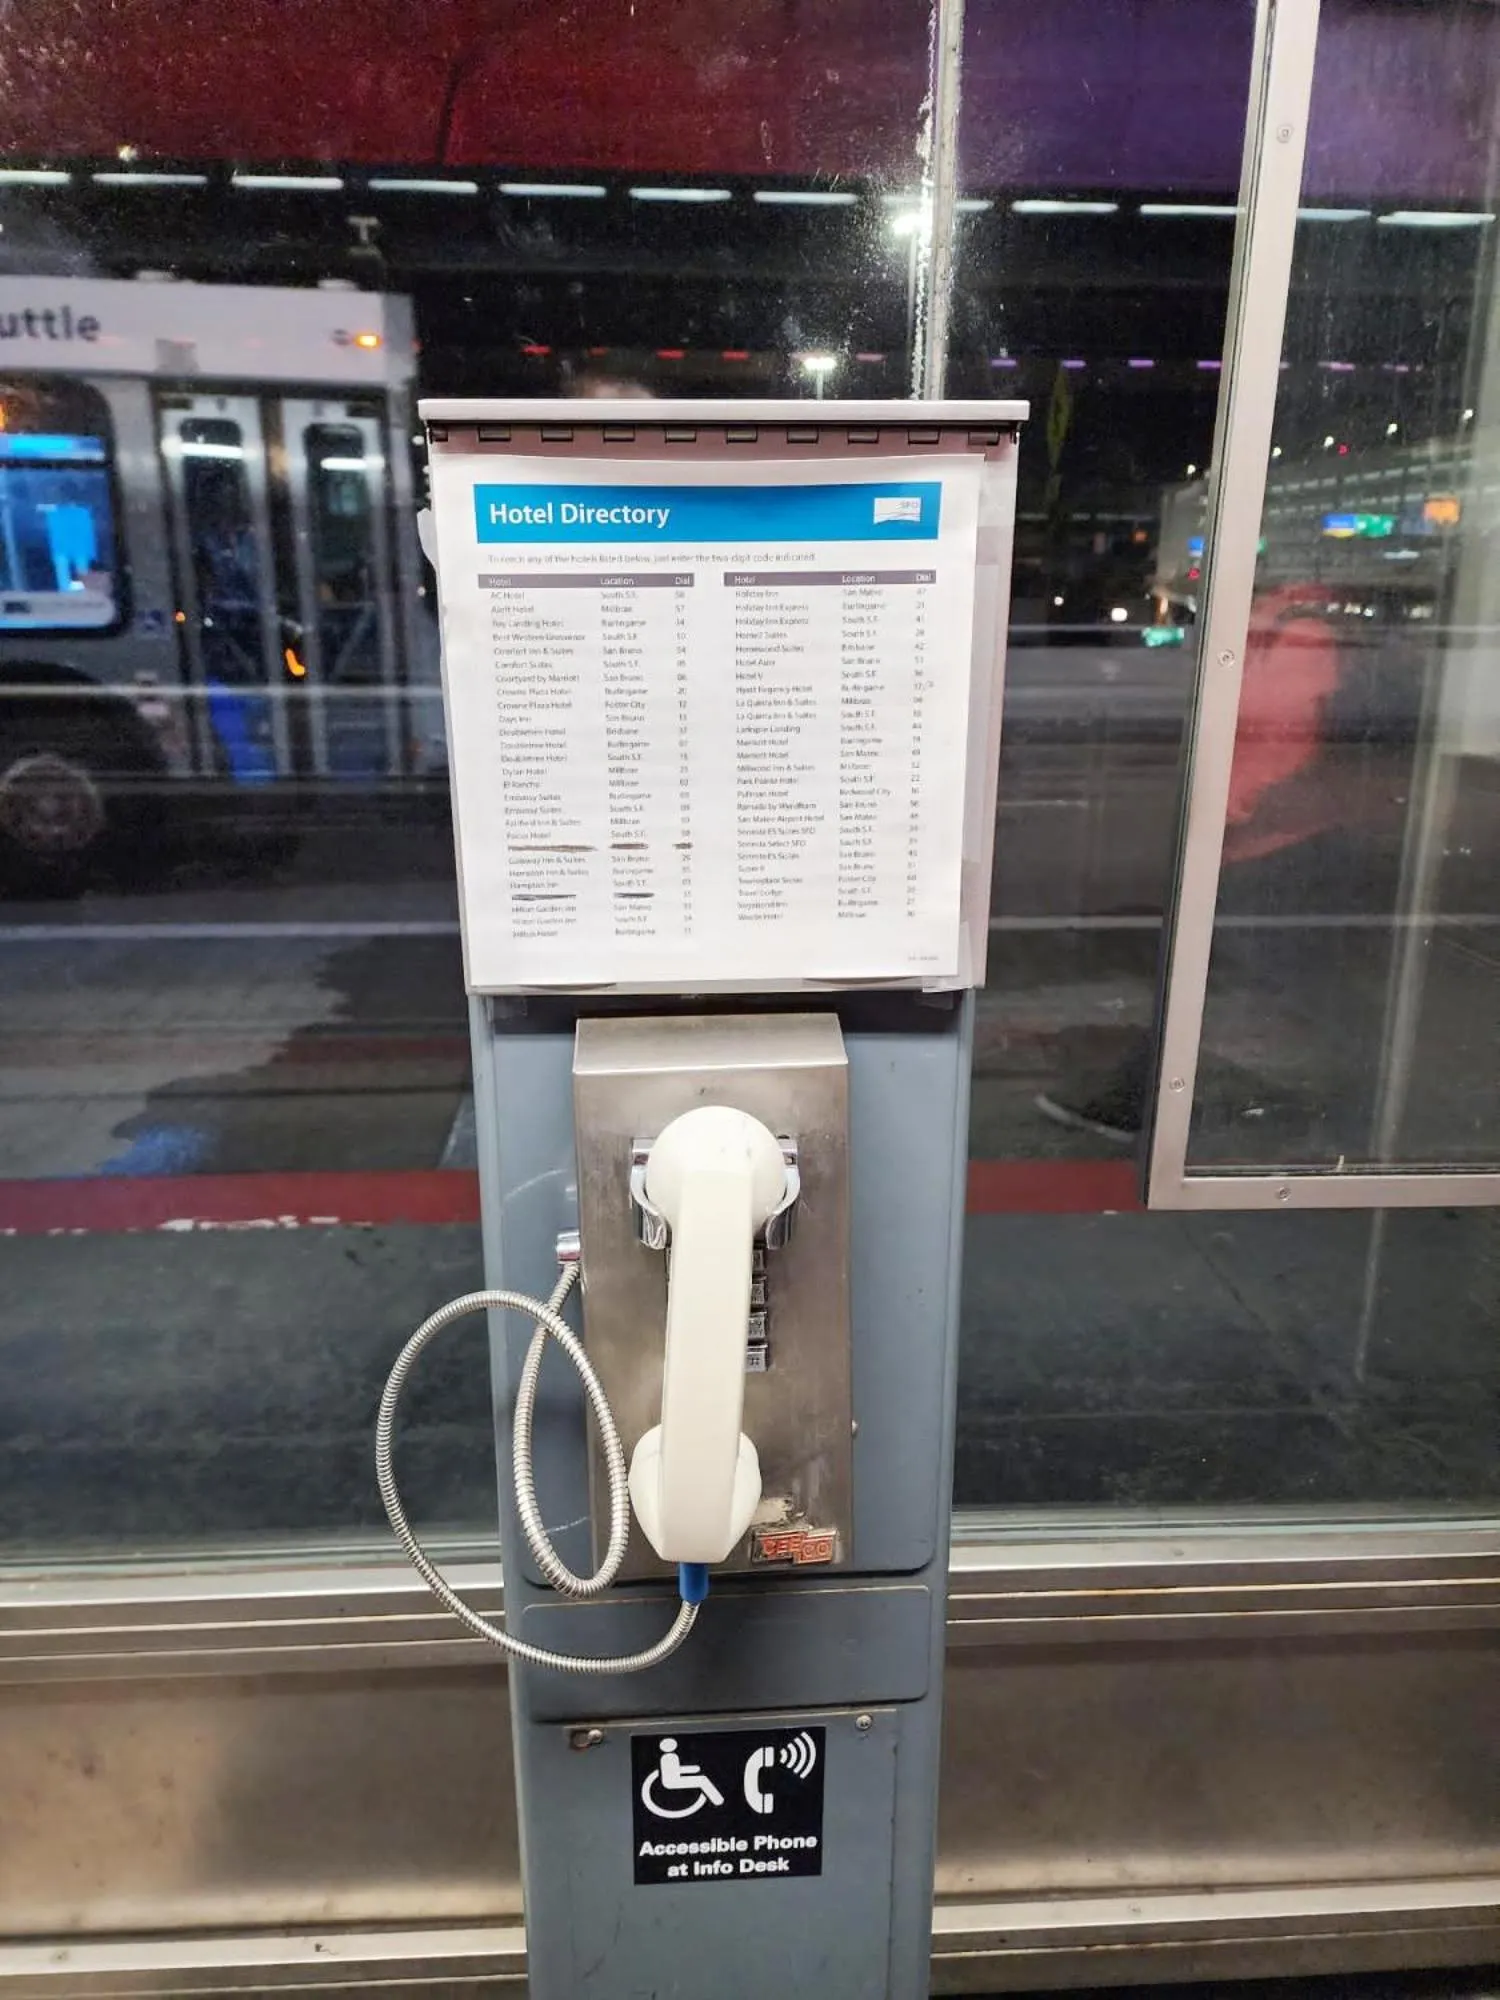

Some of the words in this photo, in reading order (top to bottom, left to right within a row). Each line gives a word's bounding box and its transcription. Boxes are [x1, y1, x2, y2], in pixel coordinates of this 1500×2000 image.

[0, 304, 102, 343] uttle
[489, 502, 553, 525] Hotel
[560, 503, 671, 529] Directory
[489, 576, 512, 586] Hotel
[599, 576, 635, 586] Location
[674, 575, 690, 586] Dial
[734, 575, 756, 585] Hotel
[841, 573, 876, 584] Location
[914, 572, 932, 583] Dial
[639, 1836, 749, 1857] Accessible
[753, 1834, 818, 1852] Phone
[667, 1862, 689, 1877] at
[693, 1860, 734, 1876] Info
[739, 1856, 790, 1874] Desk
